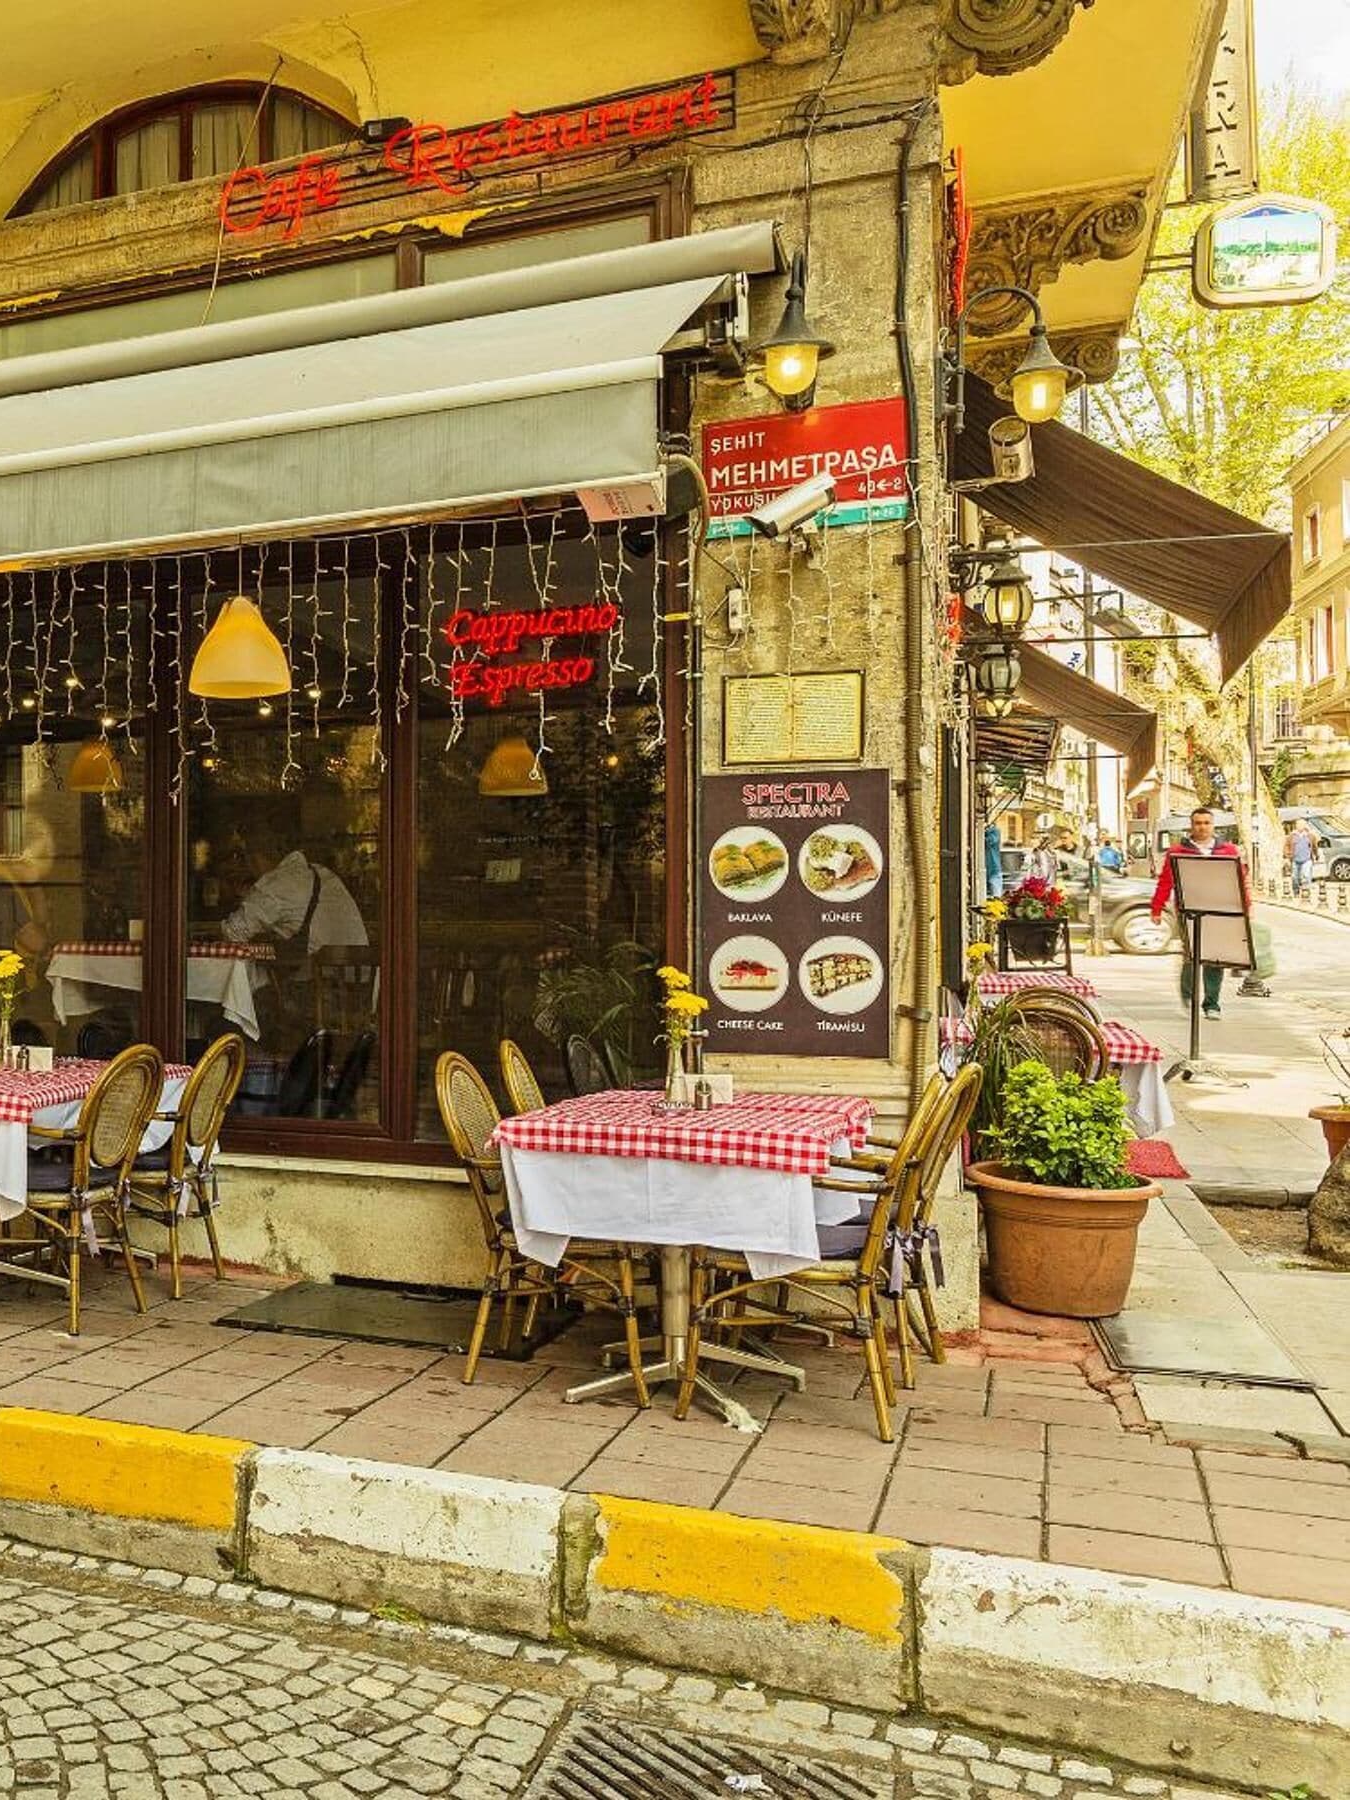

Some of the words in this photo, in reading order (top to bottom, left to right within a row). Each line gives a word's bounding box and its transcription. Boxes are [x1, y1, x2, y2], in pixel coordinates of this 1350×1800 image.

[218, 155, 341, 239] Cafe
[384, 72, 720, 197] Restaurant
[710, 432, 766, 456] ŞEHİT
[711, 444, 898, 489] MEHMETPAŞA
[446, 603, 617, 656] Cappucino
[451, 657, 594, 706] Espresso
[741, 781, 850, 805] SPECTRA
[727, 911, 773, 923] BAKLAVA
[820, 910, 863, 923] KÜNEFE
[717, 1019, 754, 1030] CHEESE
[756, 1020, 784, 1031] CAKE
